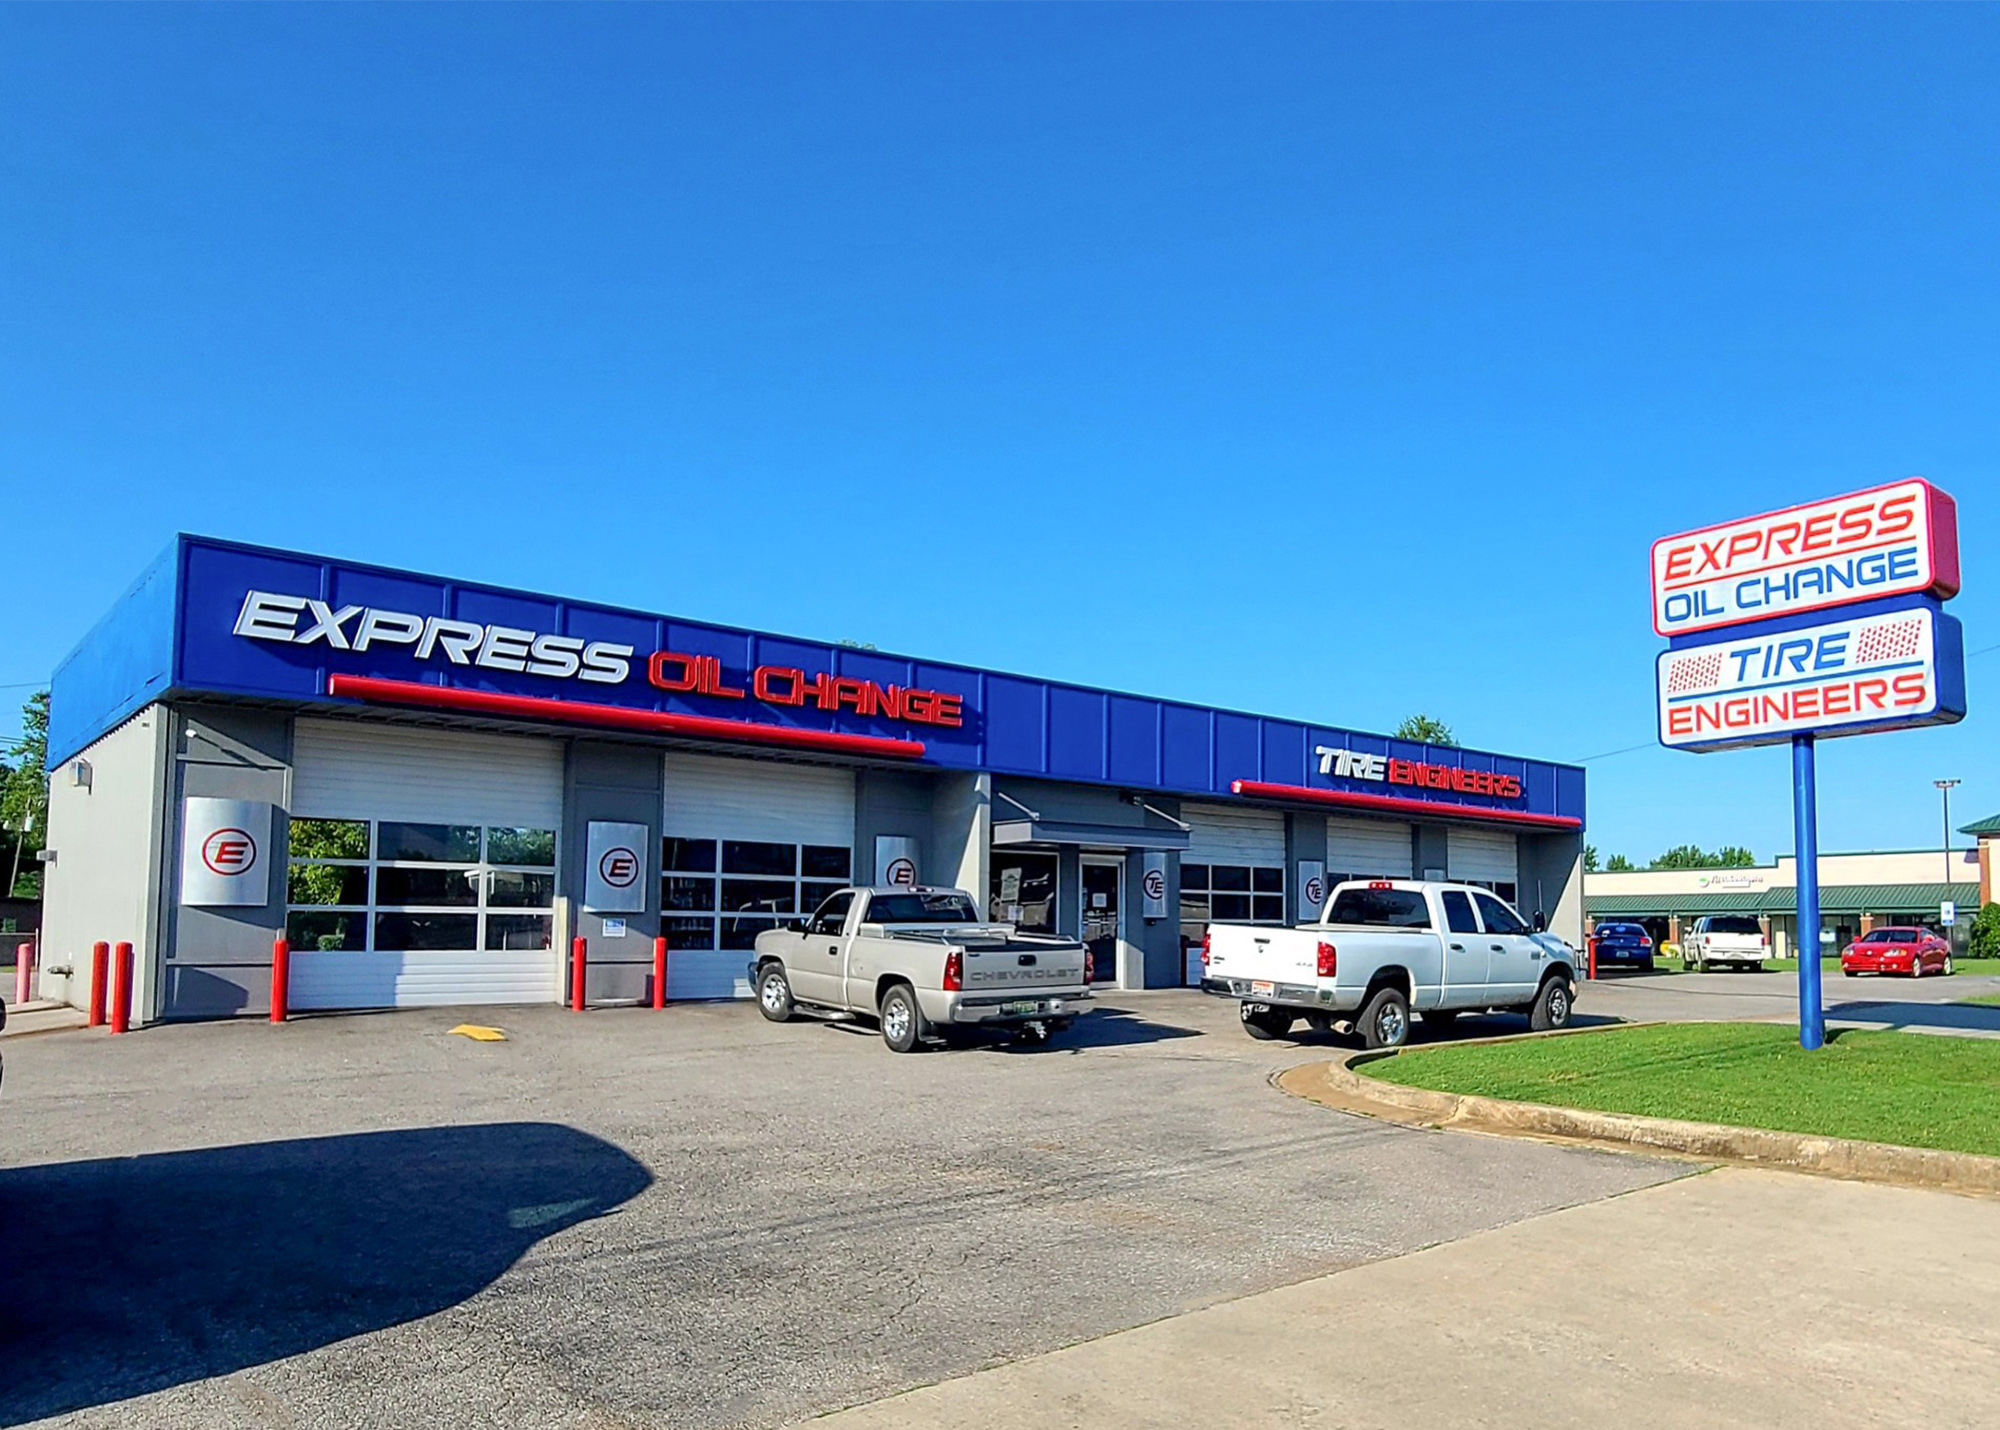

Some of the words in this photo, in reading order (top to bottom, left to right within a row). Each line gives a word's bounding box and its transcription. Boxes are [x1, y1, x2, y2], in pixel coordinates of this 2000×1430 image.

[1664, 494, 1917, 582] EXPRESS
[1664, 589, 1725, 623] OIL
[1735, 546, 1918, 609] CHANGE
[233, 590, 634, 684] EXPRESS
[648, 650, 745, 699] OIL
[753, 665, 963, 728] CHANGE
[1729, 631, 1851, 682] TIRE
[1668, 673, 1926, 735] ENGINEERS
[1316, 745, 1387, 781] TIRE
[1388, 757, 1521, 798] ENGINEERS
[214, 842, 249, 864] E
[609, 858, 634, 877] E
[894, 868, 912, 884] E
[970, 968, 1080, 981] CHEVROLET
